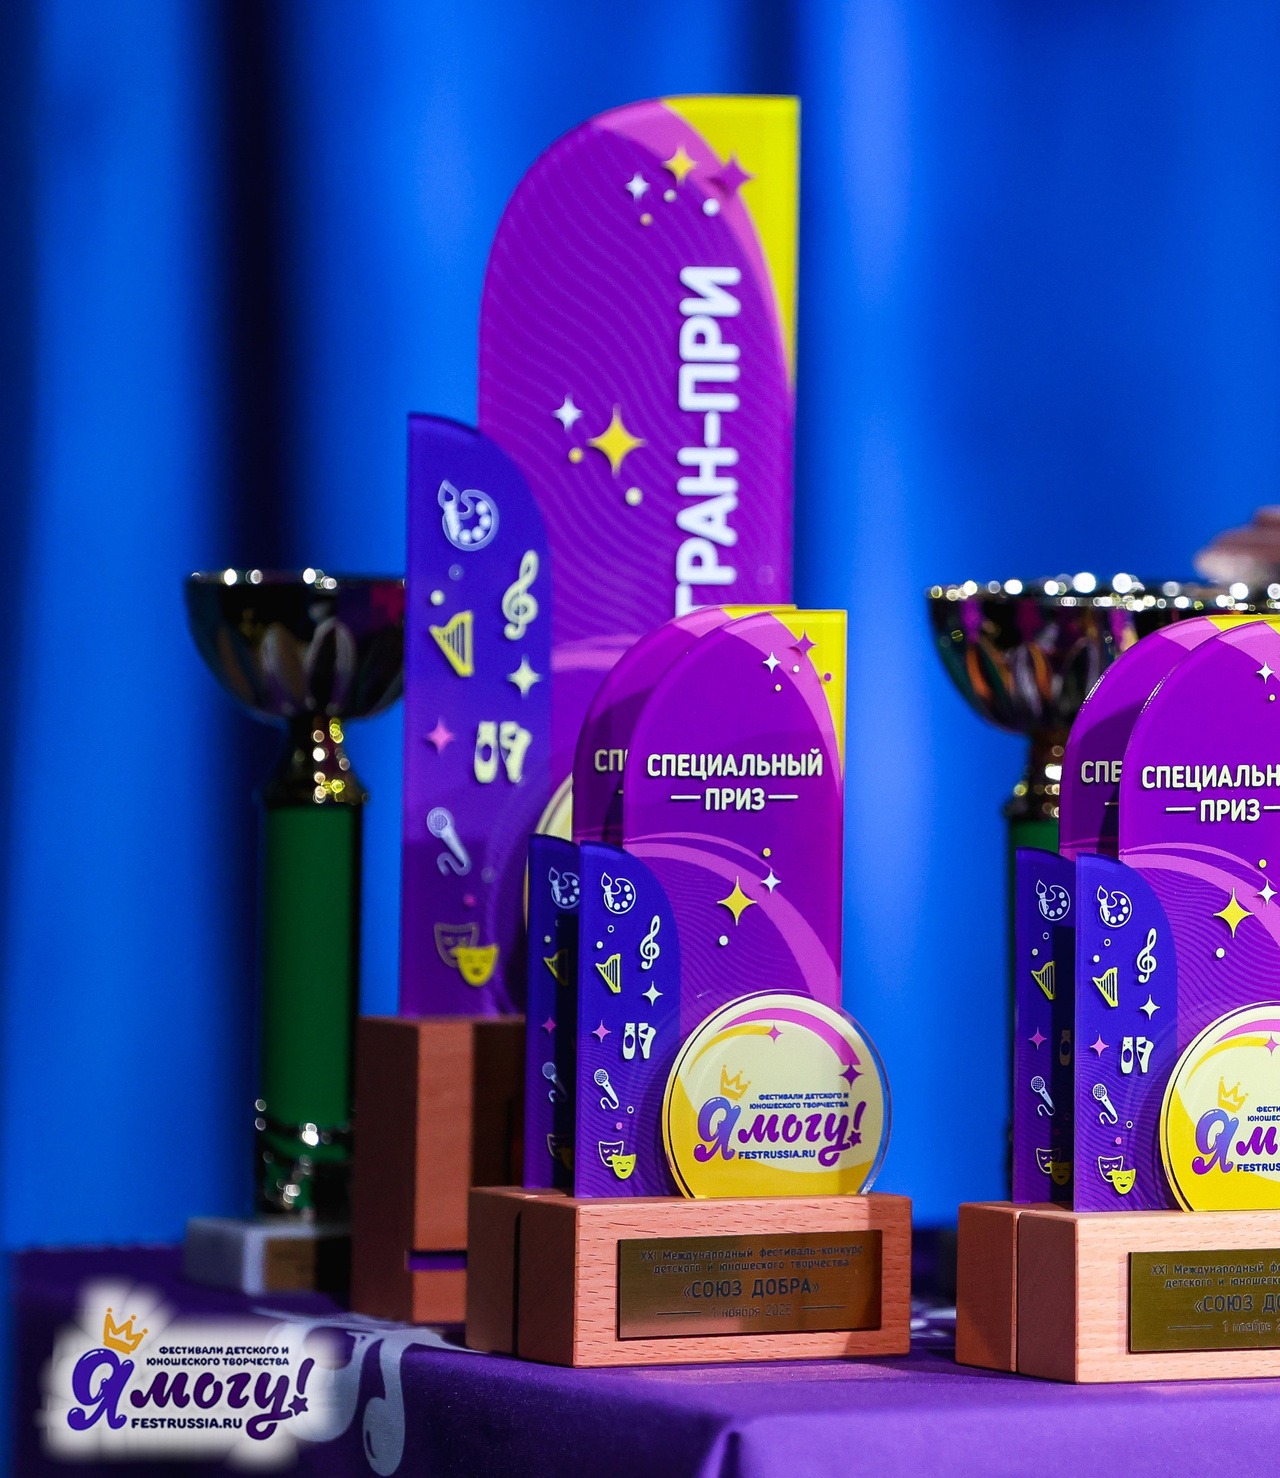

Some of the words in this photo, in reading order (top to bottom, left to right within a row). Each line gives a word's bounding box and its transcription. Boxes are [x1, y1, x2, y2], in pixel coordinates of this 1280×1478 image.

[647, 748, 823, 780] СПЕЦИАЛЬНЫЙ
[705, 787, 766, 811] ПРИЗ
[1200, 799, 1261, 822] ПРИЗ
[758, 1093, 803, 1101] ФЕСТИВАЛИ
[805, 1092, 841, 1100] ДЕТСКОГО
[750, 1102, 801, 1110] ЮНОШЕСКОГО
[803, 1101, 849, 1109] ТВОРЧЕСТВА
[693, 1096, 742, 1163] Я
[737, 1101, 867, 1167] могу!
[1192, 1108, 1240, 1175] Я
[738, 1149, 816, 1160] FESTRUSSIA.RU
[662, 1249, 753, 1263] Международный
[653, 1264, 701, 1276] детского
[719, 1261, 785, 1272] юношеского
[790, 1259, 849, 1270] творчества
[1151, 1265, 1168, 1275] XXI
[1173, 1262, 1264, 1277] Международный
[683, 1280, 743, 1299] «СОЮЗ
[751, 1277, 820, 1298] ДОБРА»
[1164, 1278, 1212, 1289] детского
[1194, 1294, 1253, 1313] «СОЮЗ
[721, 1305, 761, 1319] ноября
[1221, 1320, 1228, 1334] 1
[1232, 1319, 1272, 1334] ноября
